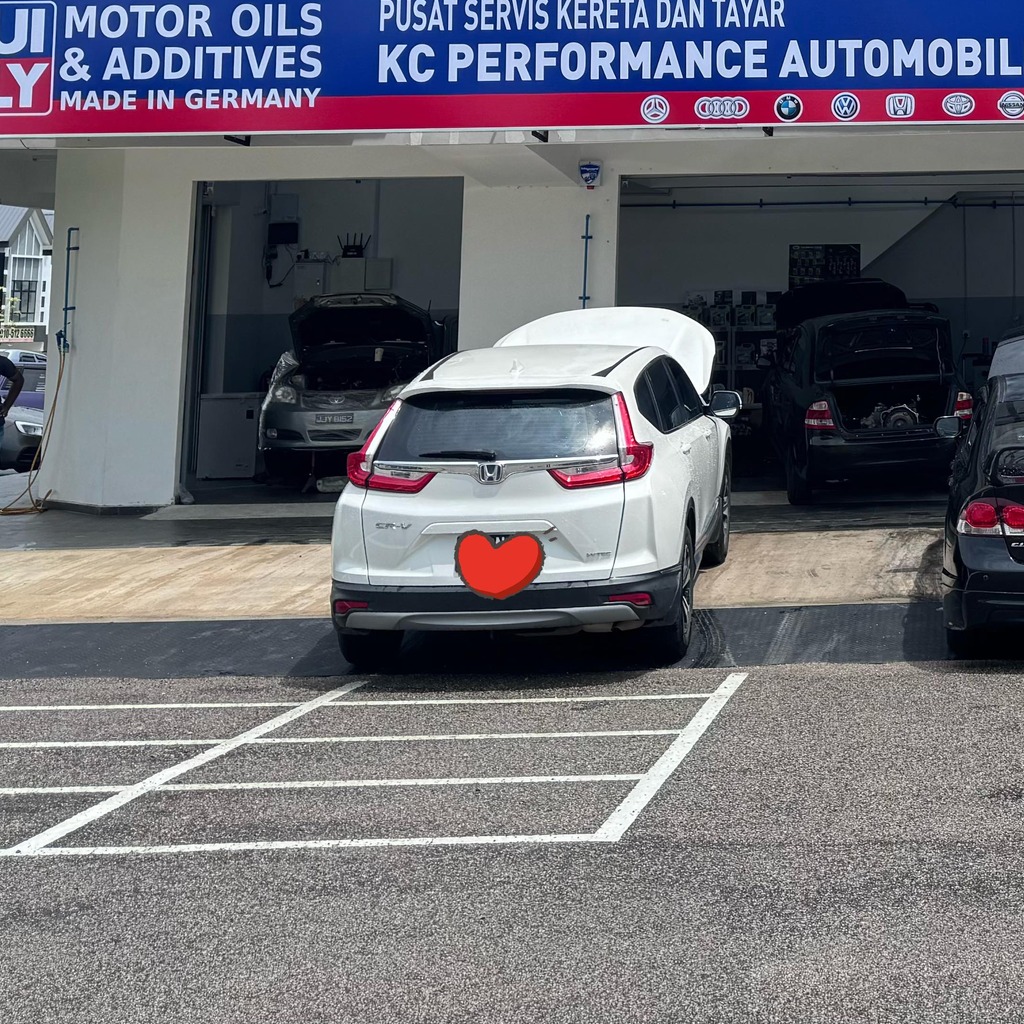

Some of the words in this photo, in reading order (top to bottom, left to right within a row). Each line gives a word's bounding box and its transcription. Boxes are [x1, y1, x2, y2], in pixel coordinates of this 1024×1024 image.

[64, 4, 213, 39] MOTOR
[231, 3, 323, 38] OILS
[59, 47, 92, 82] &
[102, 45, 323, 80] ADDITIVES
[378, 43, 435, 83] KC
[448, 39, 768, 82] PERFORMANCE
[60, 90, 137, 111] MADE
[147, 89, 175, 110] IN
[184, 87, 322, 110] GERMANY
